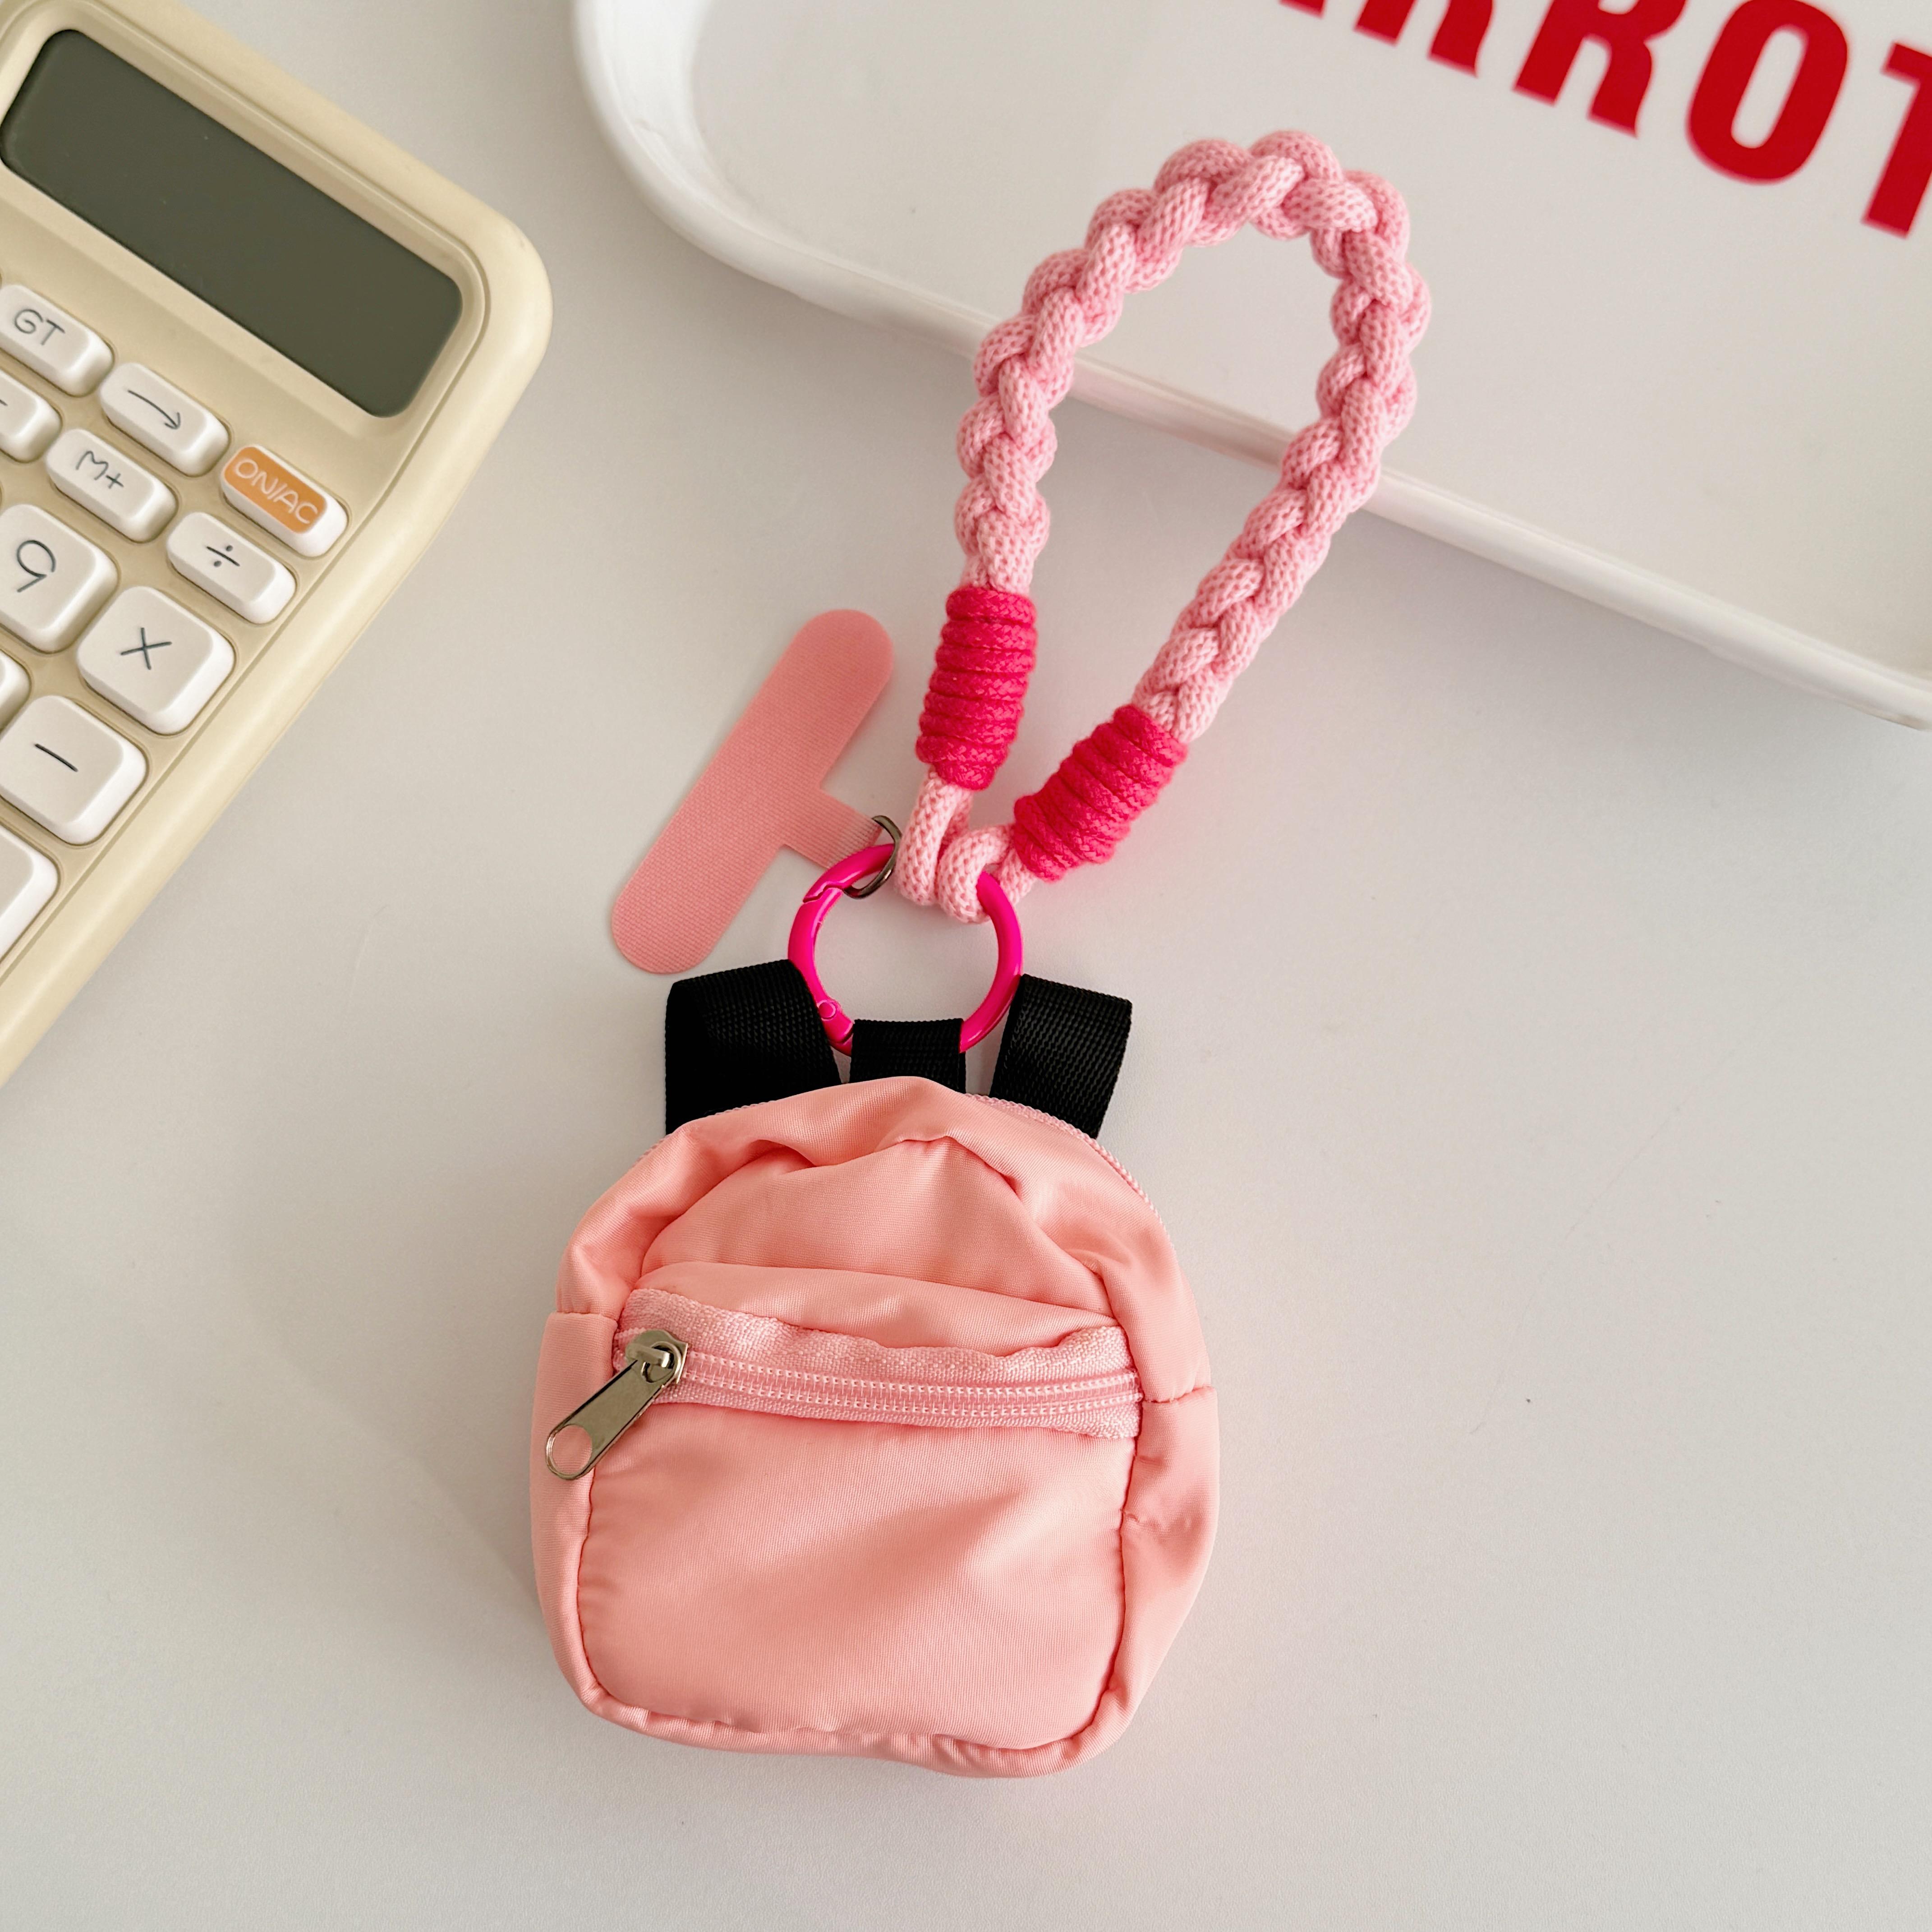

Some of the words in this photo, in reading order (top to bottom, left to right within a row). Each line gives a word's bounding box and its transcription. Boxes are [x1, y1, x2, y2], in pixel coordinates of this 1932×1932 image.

[1280, 0, 1932, 237] ROT
[13, 308, 66, 346] GT
[75, 450, 124, 489] M+
[234, 458, 318, 524] ON/AC
[15, 539, 57, 593] 9
